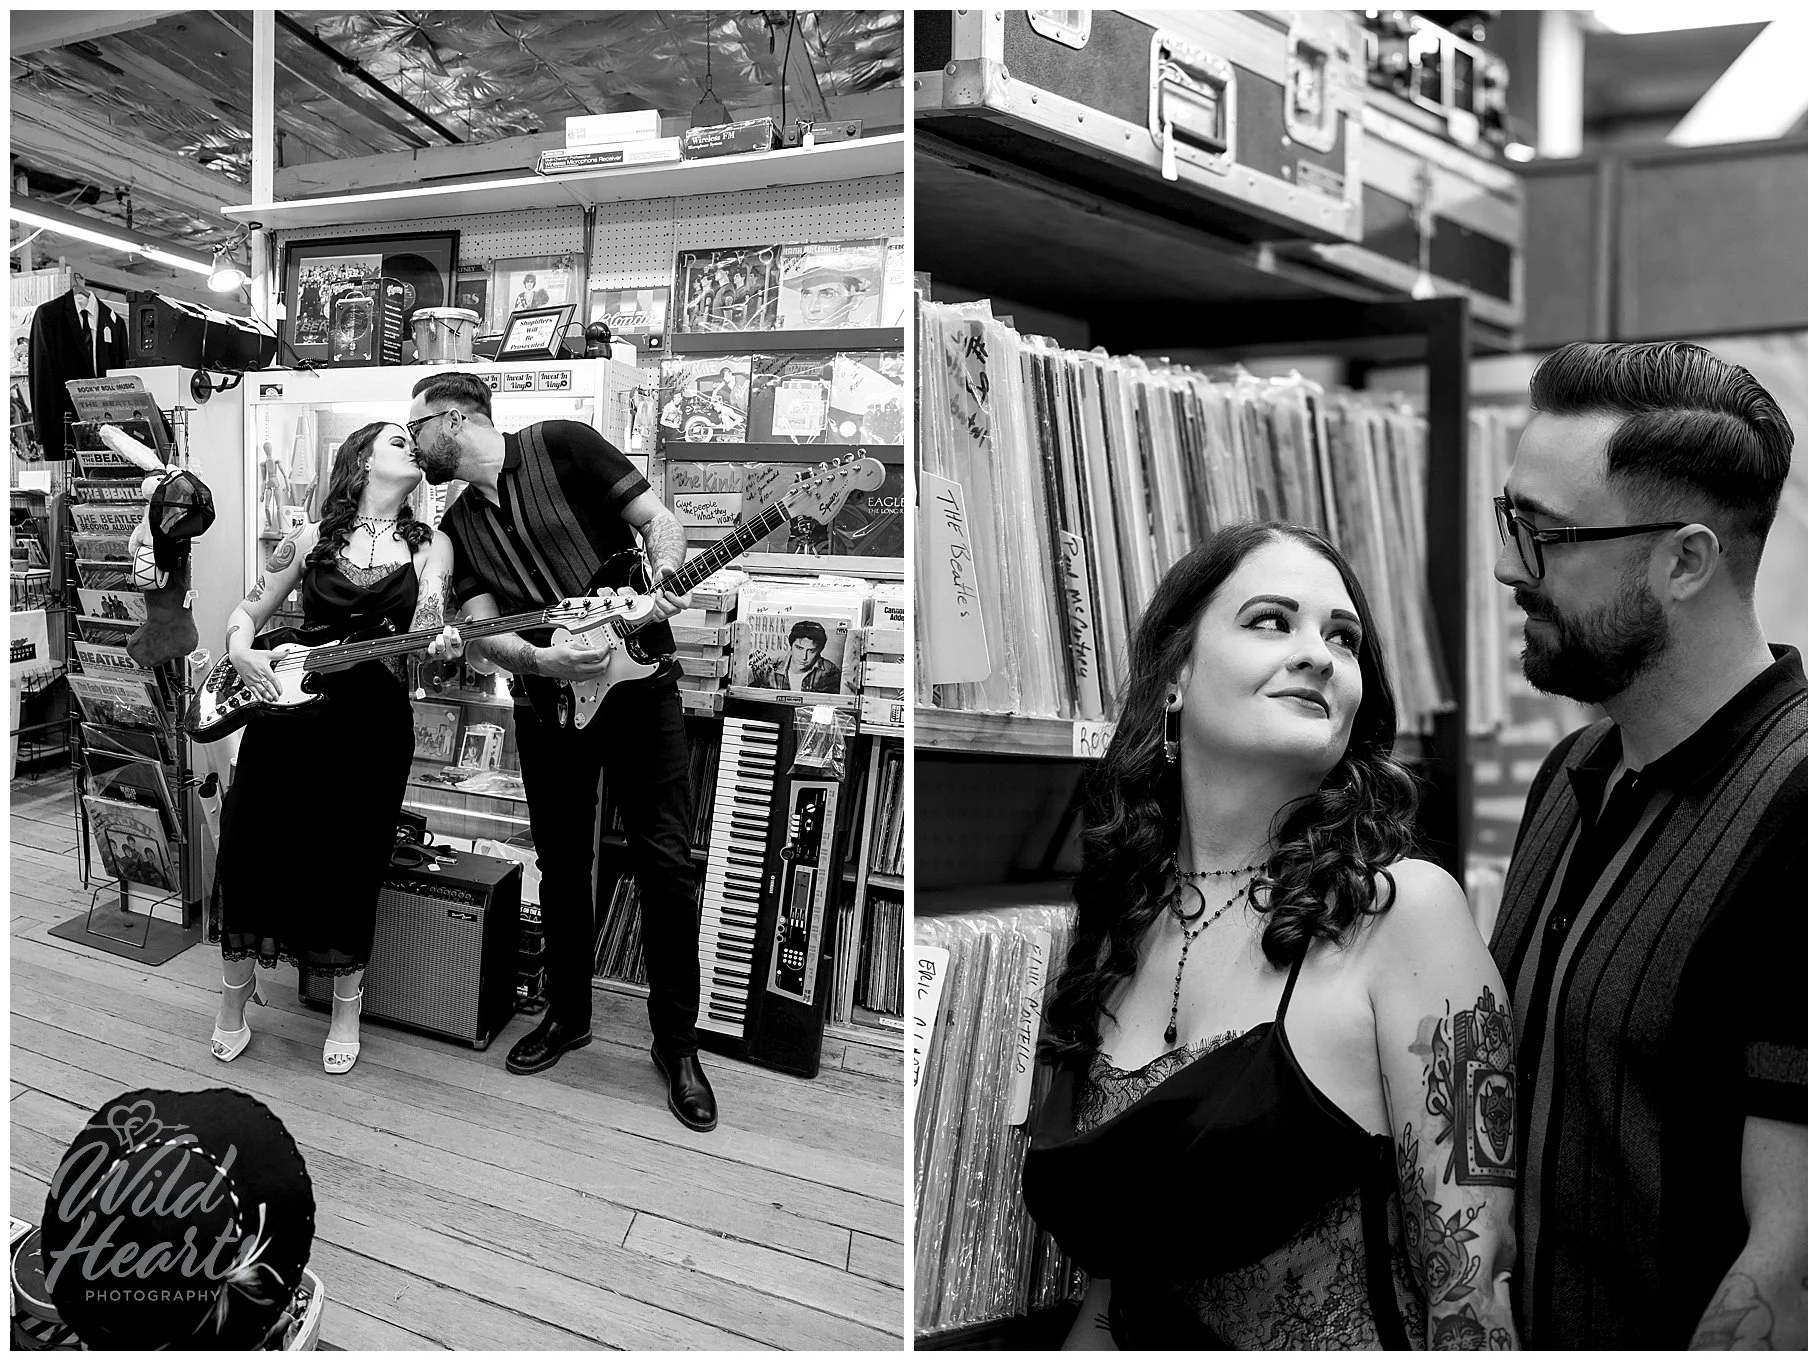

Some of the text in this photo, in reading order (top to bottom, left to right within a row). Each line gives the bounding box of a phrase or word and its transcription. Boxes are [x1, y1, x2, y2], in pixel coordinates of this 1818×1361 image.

[691, 131, 735, 144] Wireless FM
[566, 158, 597, 166] Microphone
[520, 318, 552, 326] Shoplifters
[598, 310, 663, 328] Blondie
[510, 341, 546, 350] Prosecuted
[561, 372, 568, 380] In
[116, 382, 136, 390] MUSIC
[102, 399, 146, 407] BEATLES
[77, 487, 101, 500] THE
[675, 499, 693, 510] Give
[868, 496, 904, 507] EAGLE
[682, 500, 718, 516] the people
[714, 508, 727, 517] they
[77, 514, 144, 524] THE BEATLES
[80, 523, 136, 531] SECOND ALBUM
[936, 489, 977, 618] THE Beatles
[1063, 537, 1079, 579] Paul
[749, 632, 789, 652] STEVENS
[78, 651, 135, 669] BEATLES
[917, 959, 937, 1000] ERIC
